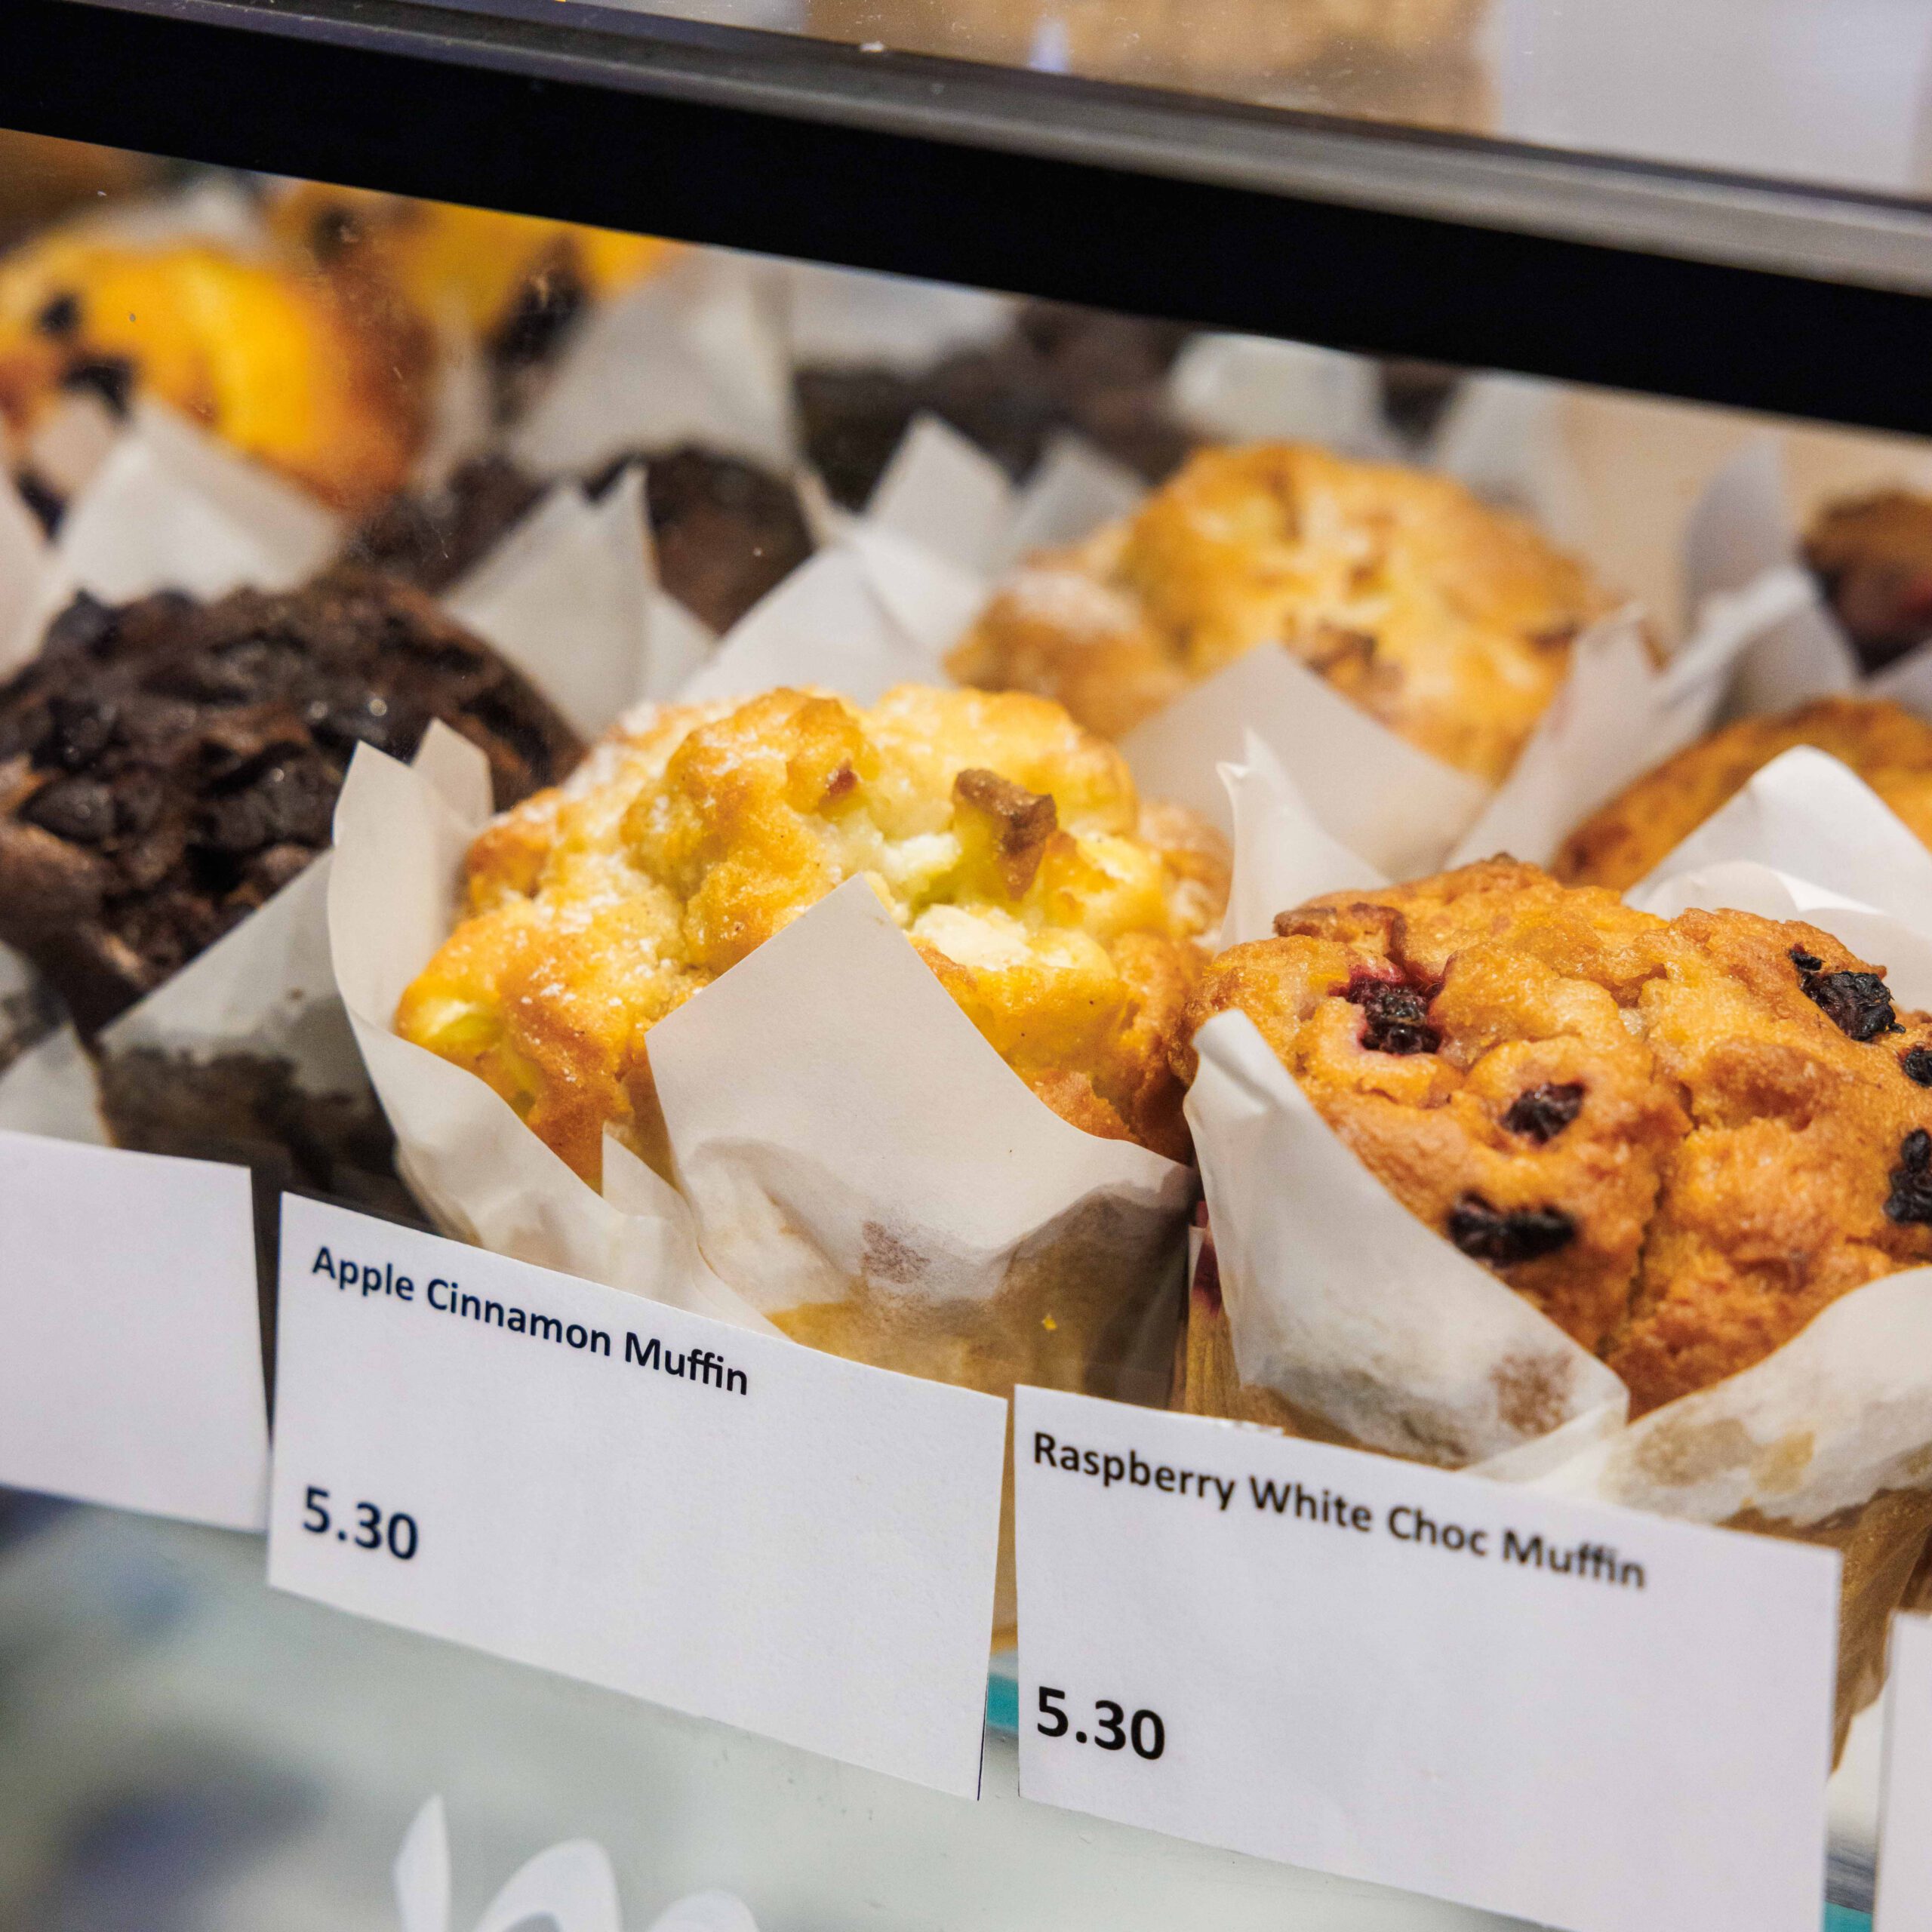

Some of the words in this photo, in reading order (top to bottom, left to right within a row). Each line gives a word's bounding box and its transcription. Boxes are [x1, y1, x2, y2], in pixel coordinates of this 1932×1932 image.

[311, 1245, 415, 1303] Apple
[426, 1278, 612, 1358] Cinnamon
[624, 1331, 749, 1396] Muffin
[303, 1484, 420, 1561] 5.30
[1033, 1431, 1236, 1512] Raspberry
[1249, 1475, 1373, 1534] White
[1387, 1505, 1487, 1557] Choc
[1502, 1529, 1645, 1588] Muffin
[1036, 1684, 1166, 1761] 5.30
